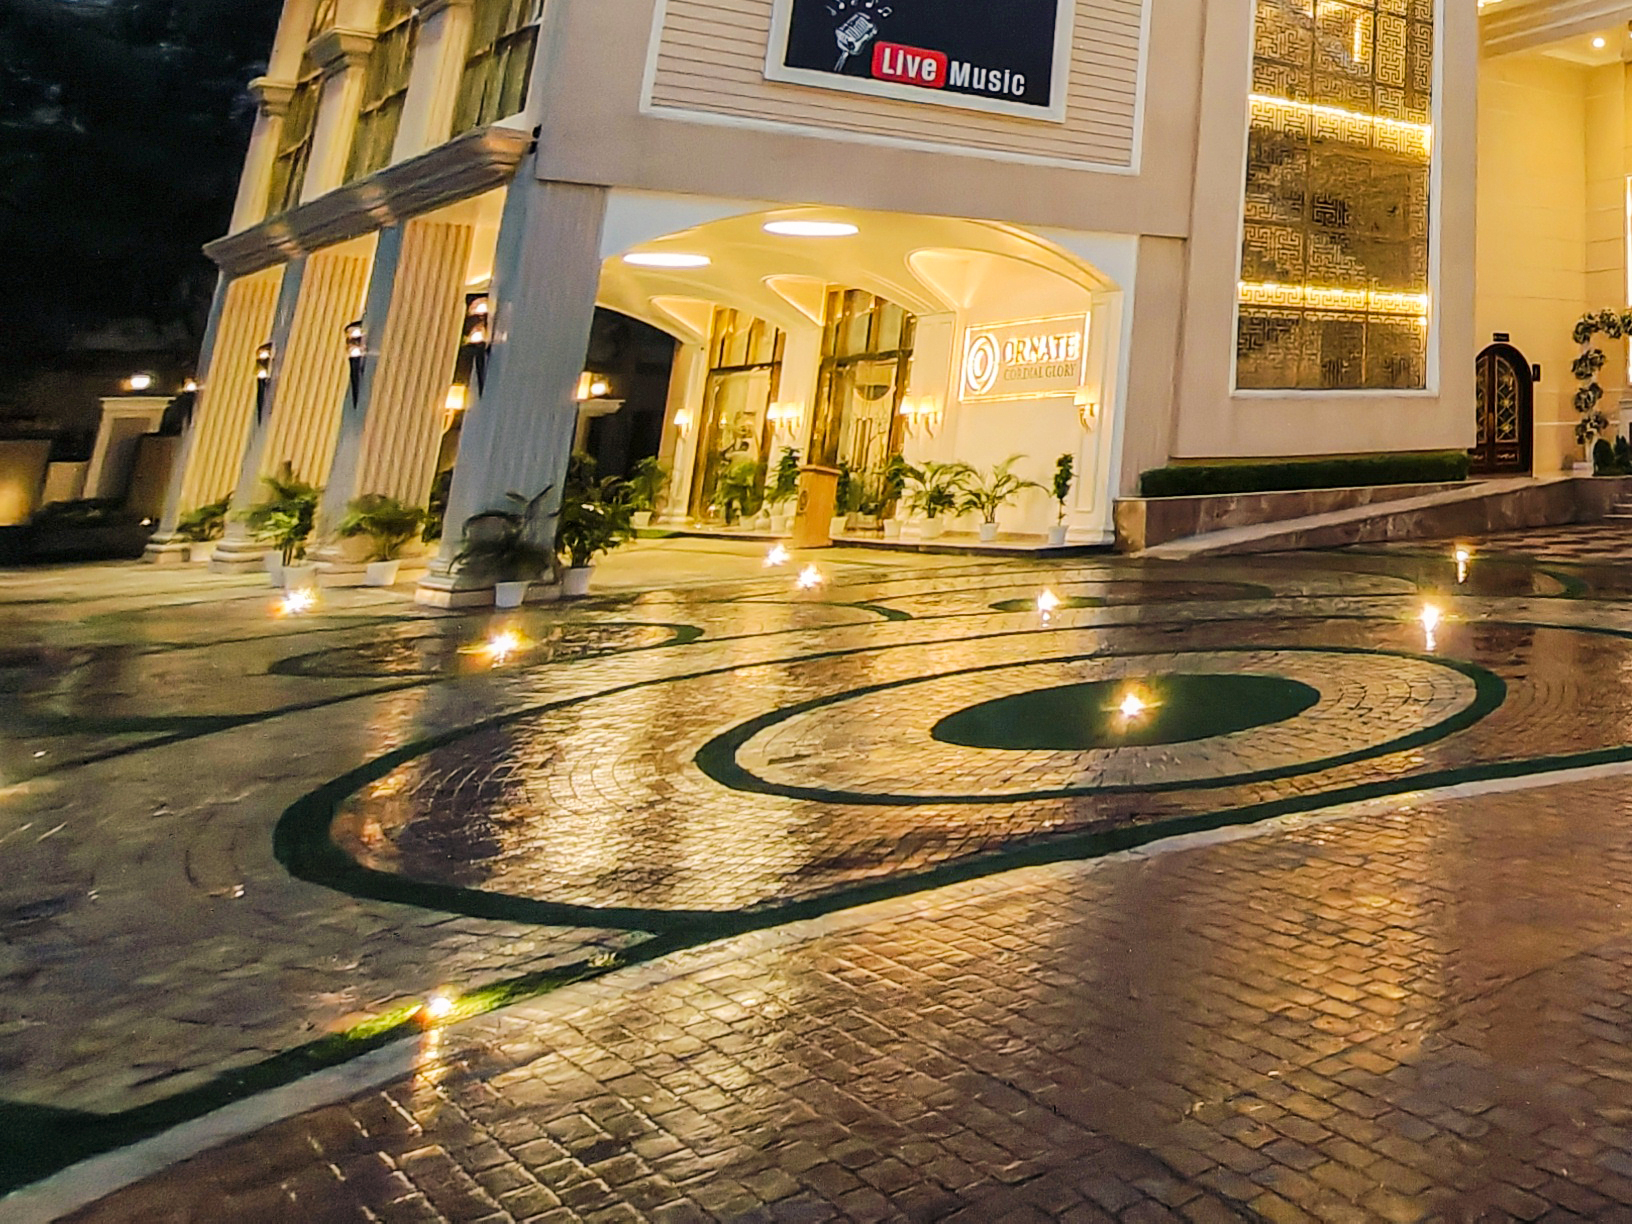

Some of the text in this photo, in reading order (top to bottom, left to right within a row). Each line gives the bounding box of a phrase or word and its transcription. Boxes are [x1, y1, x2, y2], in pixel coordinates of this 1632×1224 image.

[882, 47, 1025, 96] Live Music
[1003, 333, 1079, 366] ORNATE
[1045, 363, 1077, 378] GLORY
